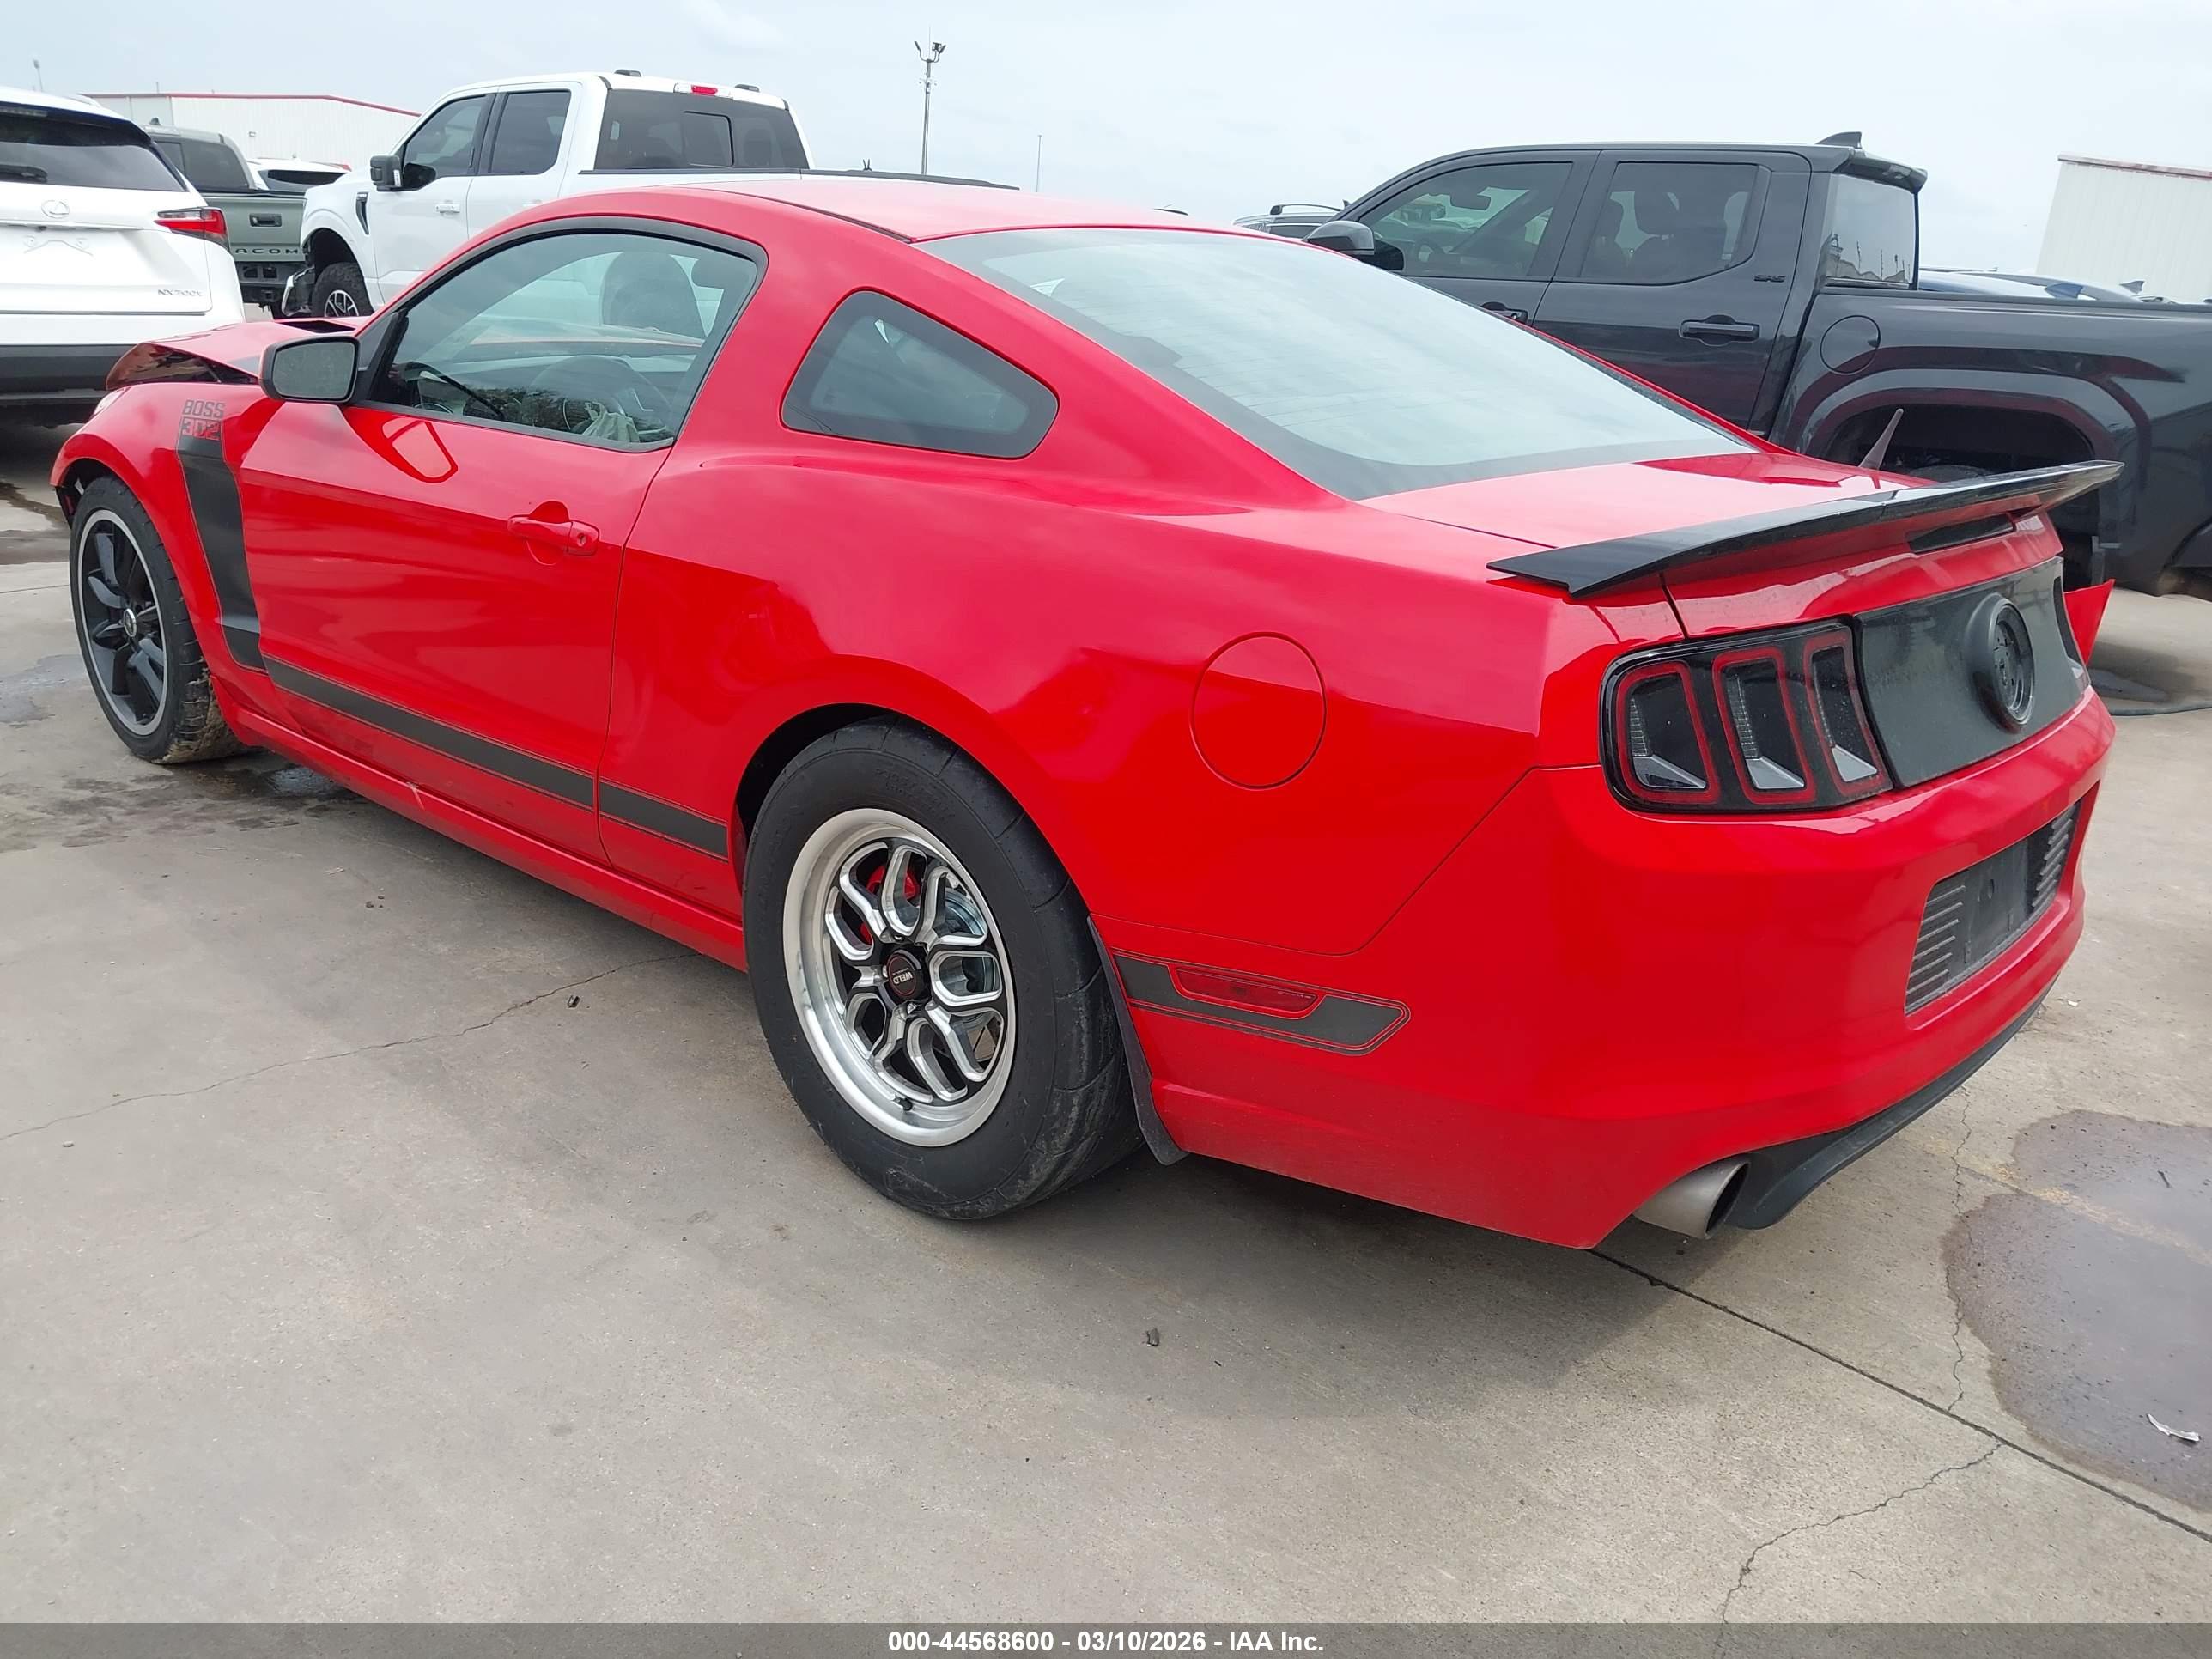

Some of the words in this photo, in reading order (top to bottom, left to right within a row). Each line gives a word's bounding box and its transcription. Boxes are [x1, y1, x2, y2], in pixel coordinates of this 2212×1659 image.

[182, 399, 225, 418] BOSS
[181, 417, 220, 440] 302
[893, 971, 914, 985] WELD
